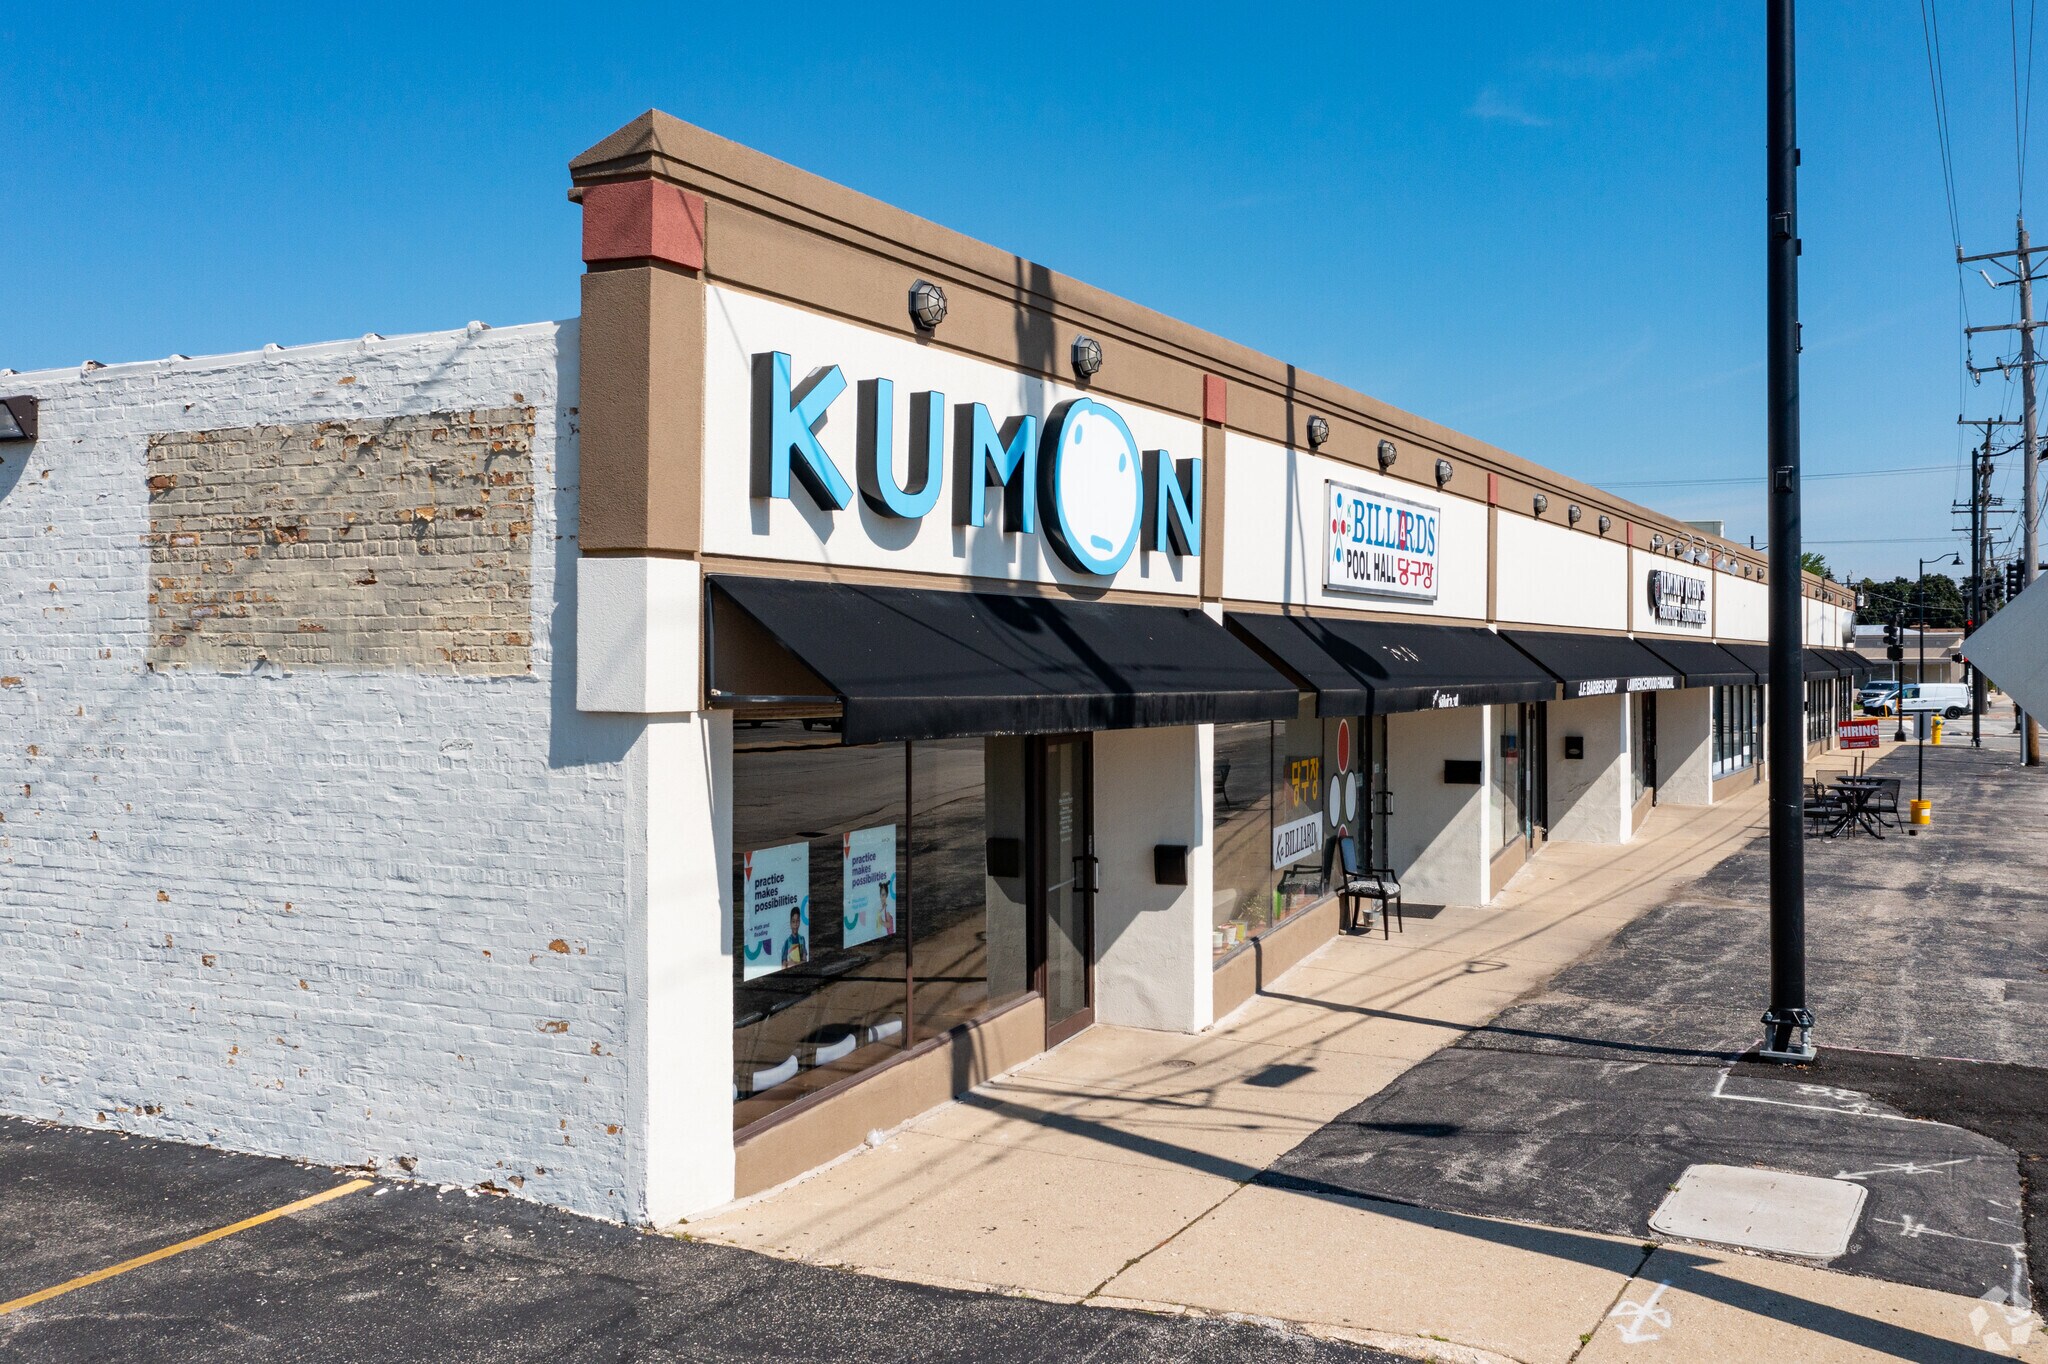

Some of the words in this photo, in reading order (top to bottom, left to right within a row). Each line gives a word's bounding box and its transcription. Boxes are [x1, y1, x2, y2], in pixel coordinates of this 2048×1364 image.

[750, 351, 1200, 575] KUMON
[1347, 549, 1370, 580] POOL
[1374, 552, 1396, 583] HALL
[1397, 558, 1434, 589] 당구장
[1839, 724, 1878, 737] HIRING
[1291, 757, 1319, 807] 당구장
[852, 852, 876, 867] practice
[852, 865, 871, 876] makes
[754, 873, 785, 890] practice
[852, 872, 887, 889] possibilities
[754, 887, 779, 900] makes
[754, 894, 798, 915] possibilities
